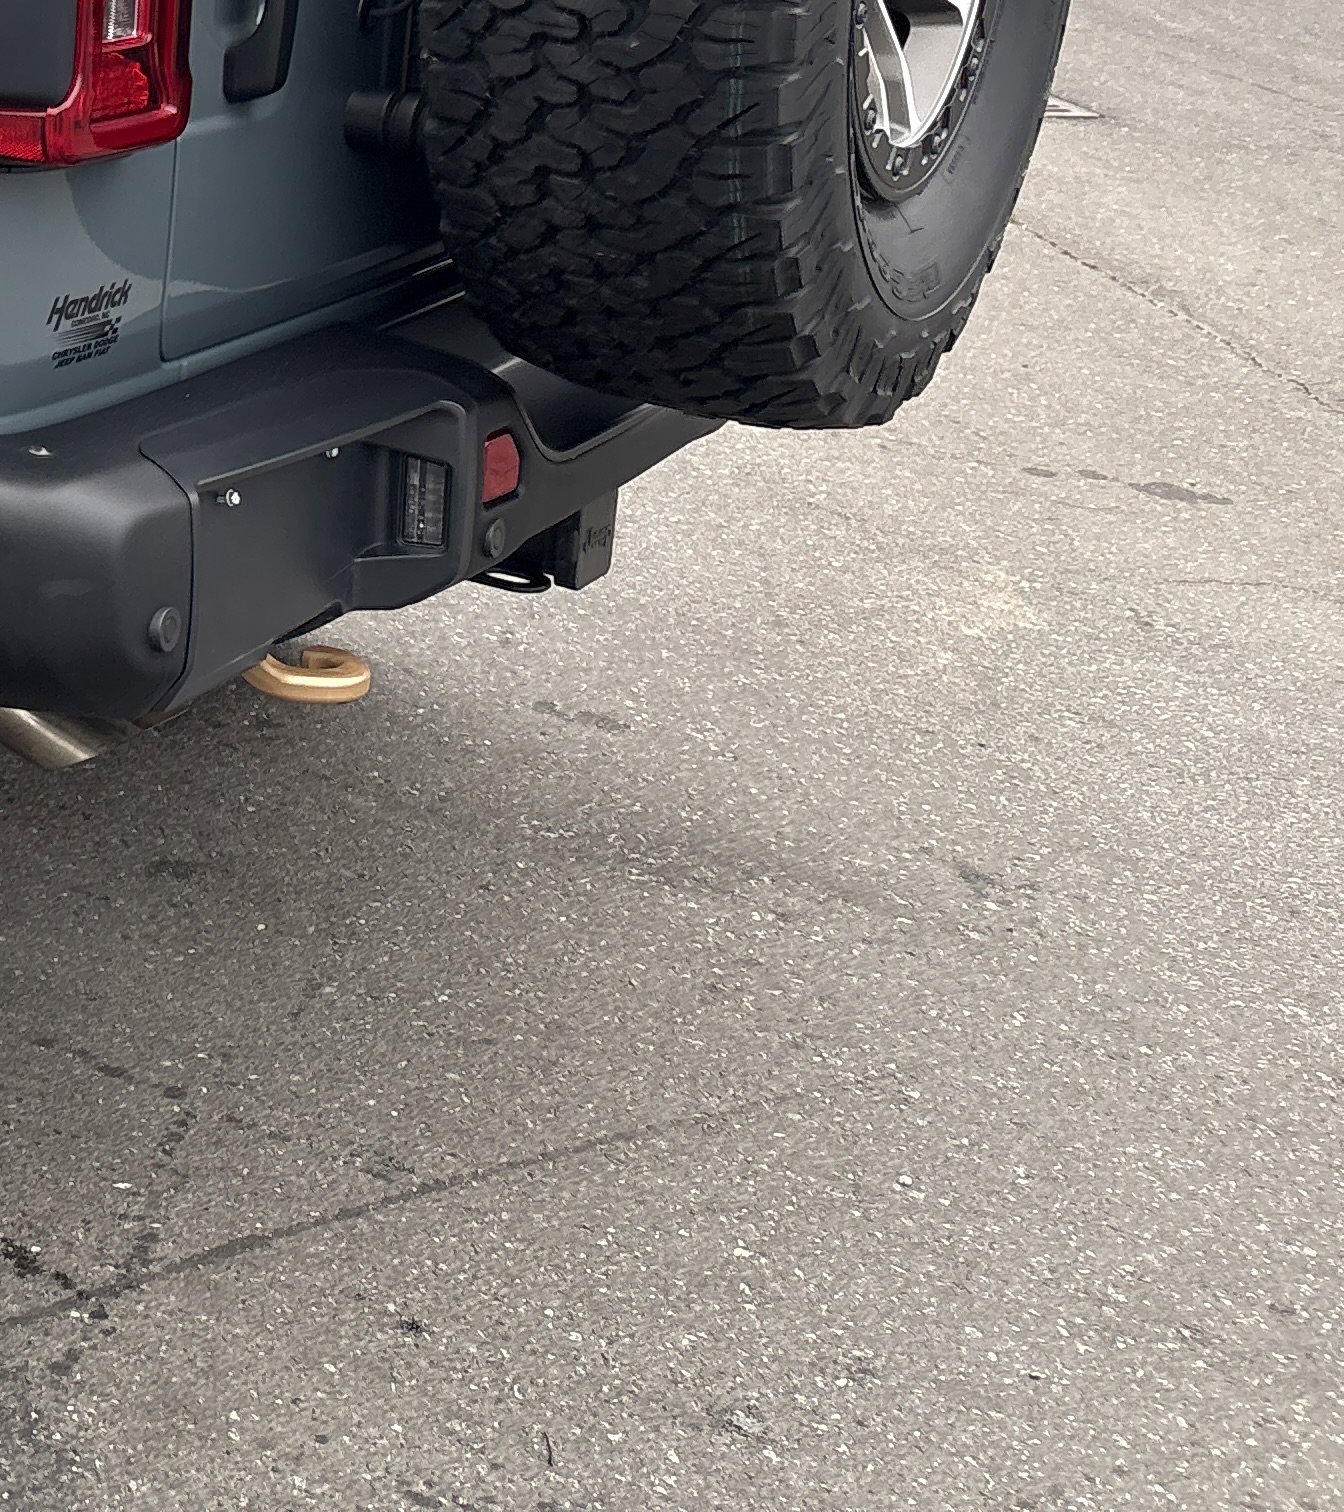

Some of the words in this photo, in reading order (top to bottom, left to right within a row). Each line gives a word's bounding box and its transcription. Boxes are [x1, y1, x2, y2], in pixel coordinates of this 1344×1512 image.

[45, 278, 133, 332] Hendrick
[51, 342, 92, 361] CHRYSLER
[94, 334, 119, 350] DODGE
